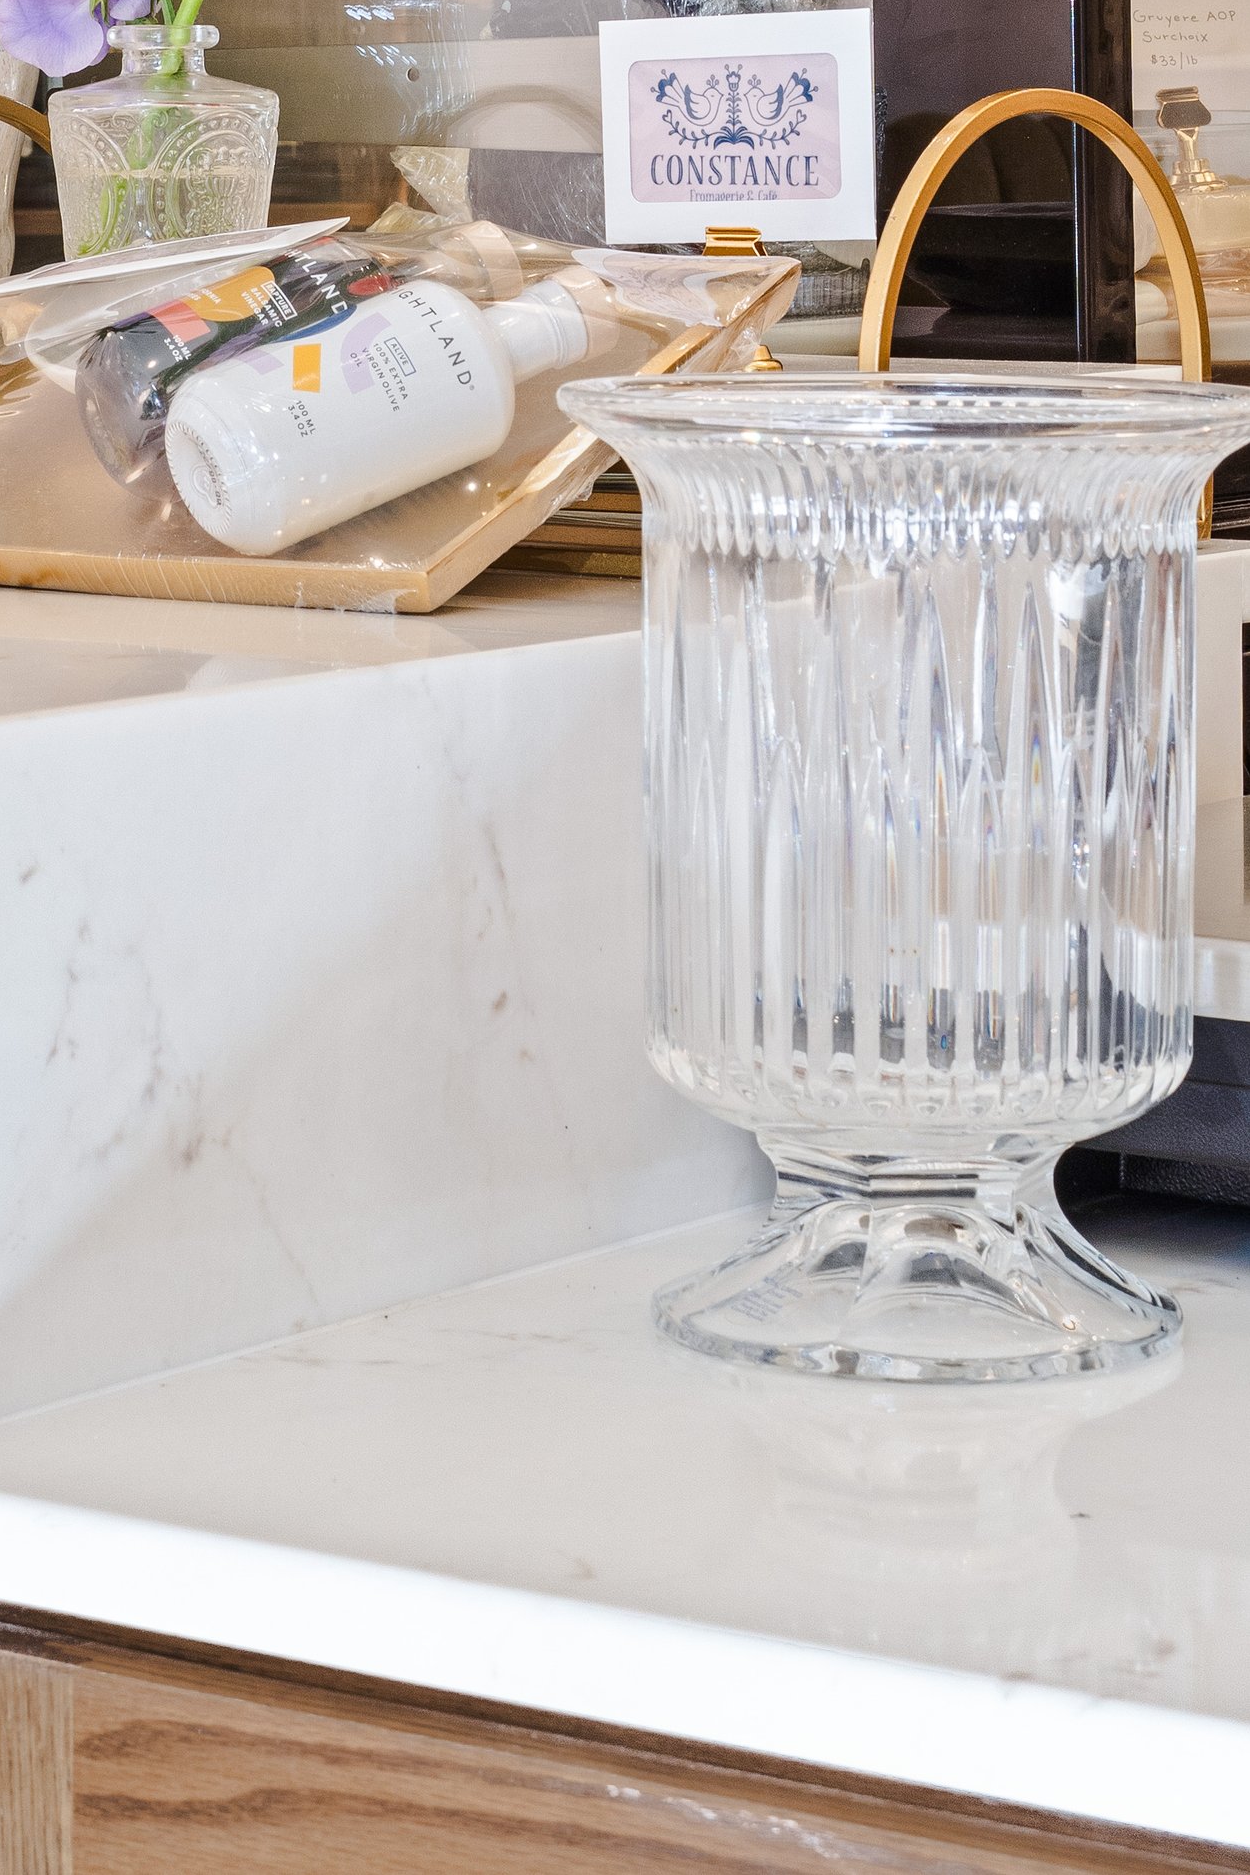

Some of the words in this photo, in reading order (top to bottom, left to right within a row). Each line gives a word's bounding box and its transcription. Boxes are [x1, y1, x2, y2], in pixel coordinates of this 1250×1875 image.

[1132, 9, 1200, 28] Gruyere
[1206, 10, 1236, 22] AOP
[1141, 30, 1209, 43] Surchoix
[650, 154, 819, 187] CONSTANCE
[240, 291, 269, 327] VINEGAR
[250, 286, 283, 329] BALSAMIC
[265, 281, 293, 317] RAPTURE
[163, 337, 176, 351] 3.4
[171, 350, 184, 363] OZ
[172, 334, 186, 350] 100
[180, 346, 193, 361] ML
[349, 351, 363, 369] OIL
[390, 342, 410, 367] ALIVE
[361, 346, 386, 380] VIRGIN
[382, 380, 401, 413] OLIVE
[372, 342, 390, 366] 100%
[388, 366, 409, 401] EXTRA
[287, 404, 301, 421] 3.4
[296, 421, 309, 439] OZ
[295, 399, 309, 418] 100
[304, 417, 317, 436] ML
